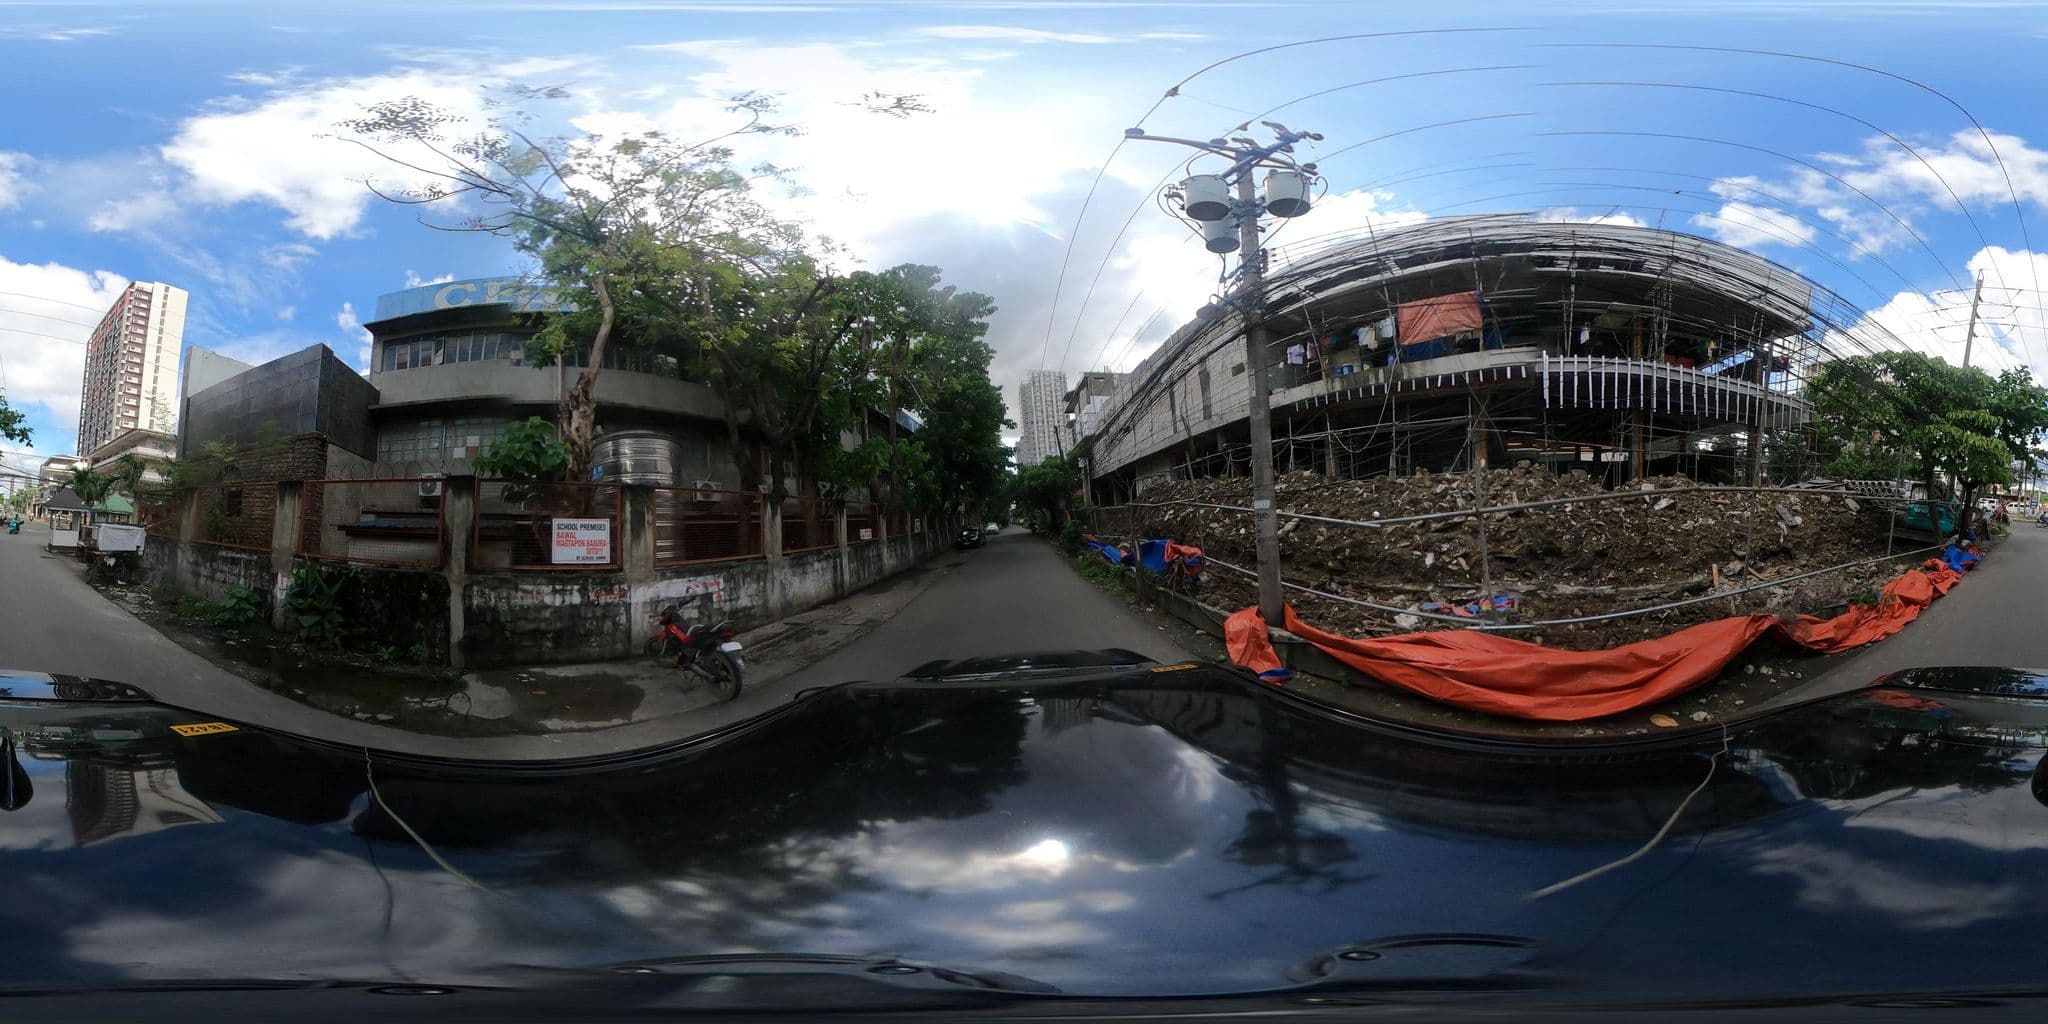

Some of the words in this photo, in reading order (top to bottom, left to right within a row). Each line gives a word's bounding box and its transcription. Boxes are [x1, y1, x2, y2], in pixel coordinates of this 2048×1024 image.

[556, 523, 578, 531] SCHOOL
[579, 523, 606, 531] PREMISES
[556, 531, 577, 539] BAWAL
[556, 539, 586, 547] MAGTAPON
[586, 539, 607, 547] BASURA
